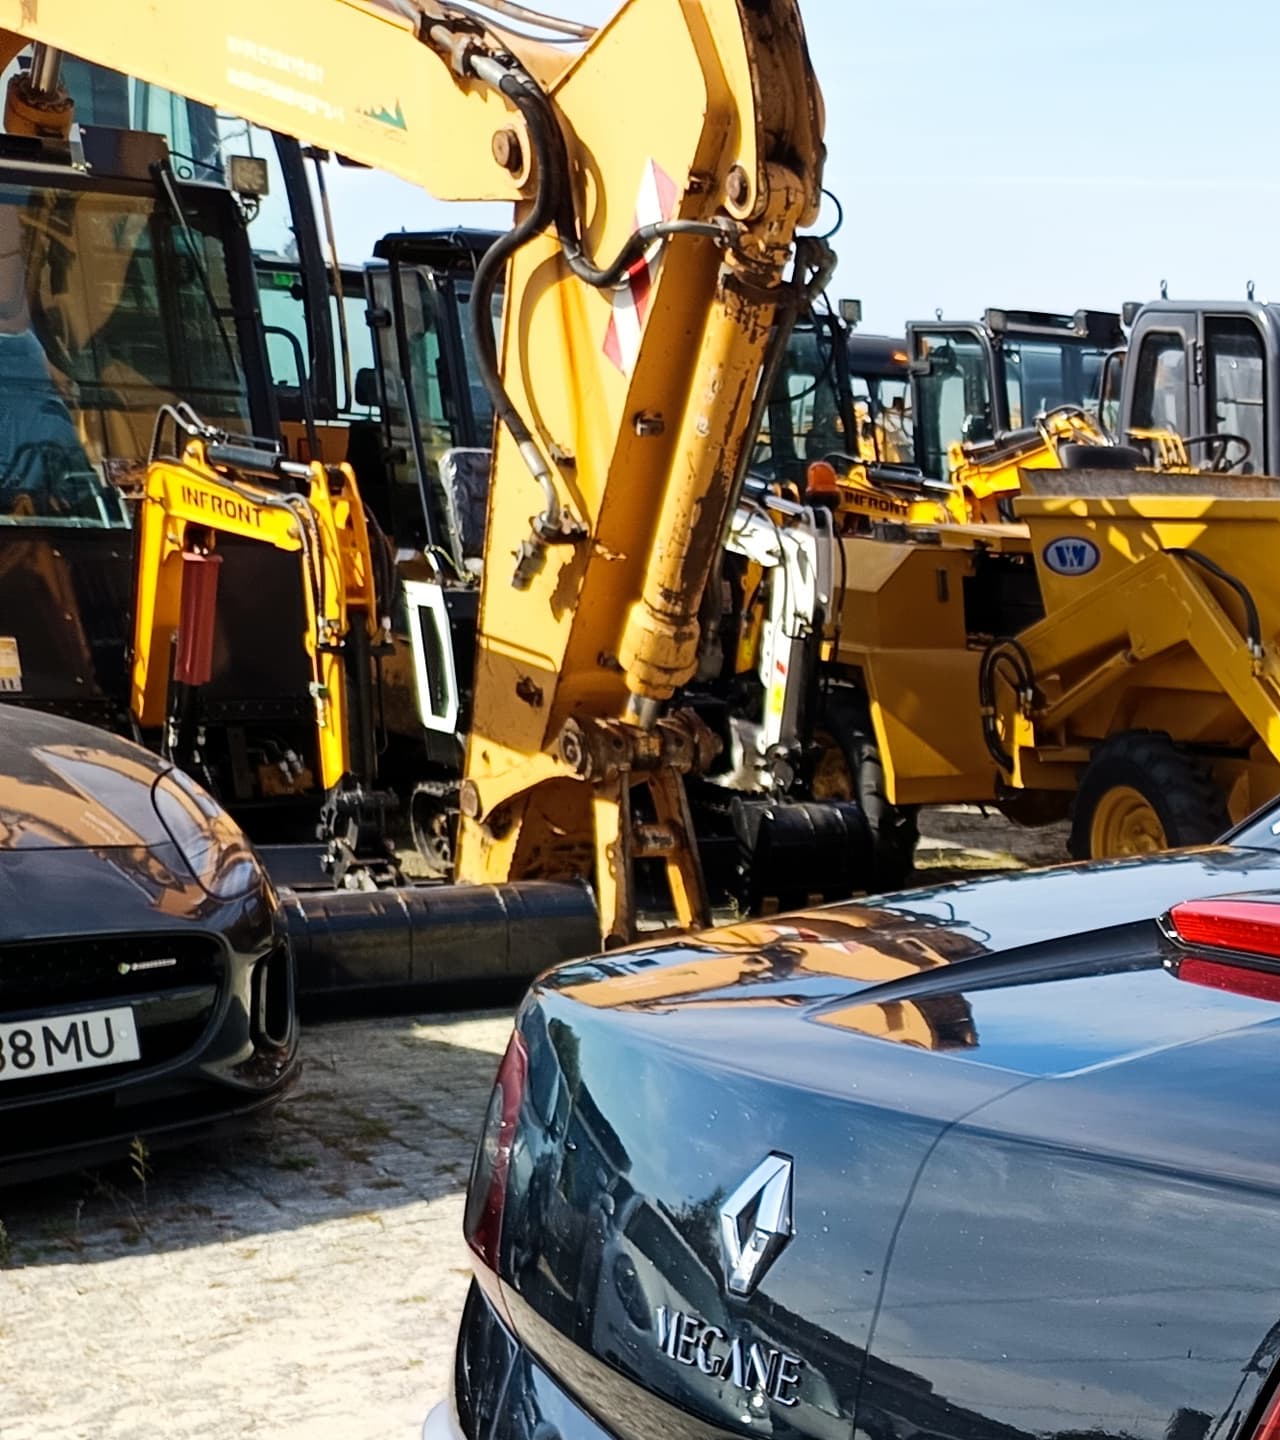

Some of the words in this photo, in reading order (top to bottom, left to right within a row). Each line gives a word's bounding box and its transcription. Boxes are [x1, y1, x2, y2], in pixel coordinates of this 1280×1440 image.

[181, 485, 263, 527] INFRONT
[844, 491, 909, 517] INFRONT
[0, 1017, 115, 1073] 8MU
[656, 1304, 802, 1407] MEGANE
